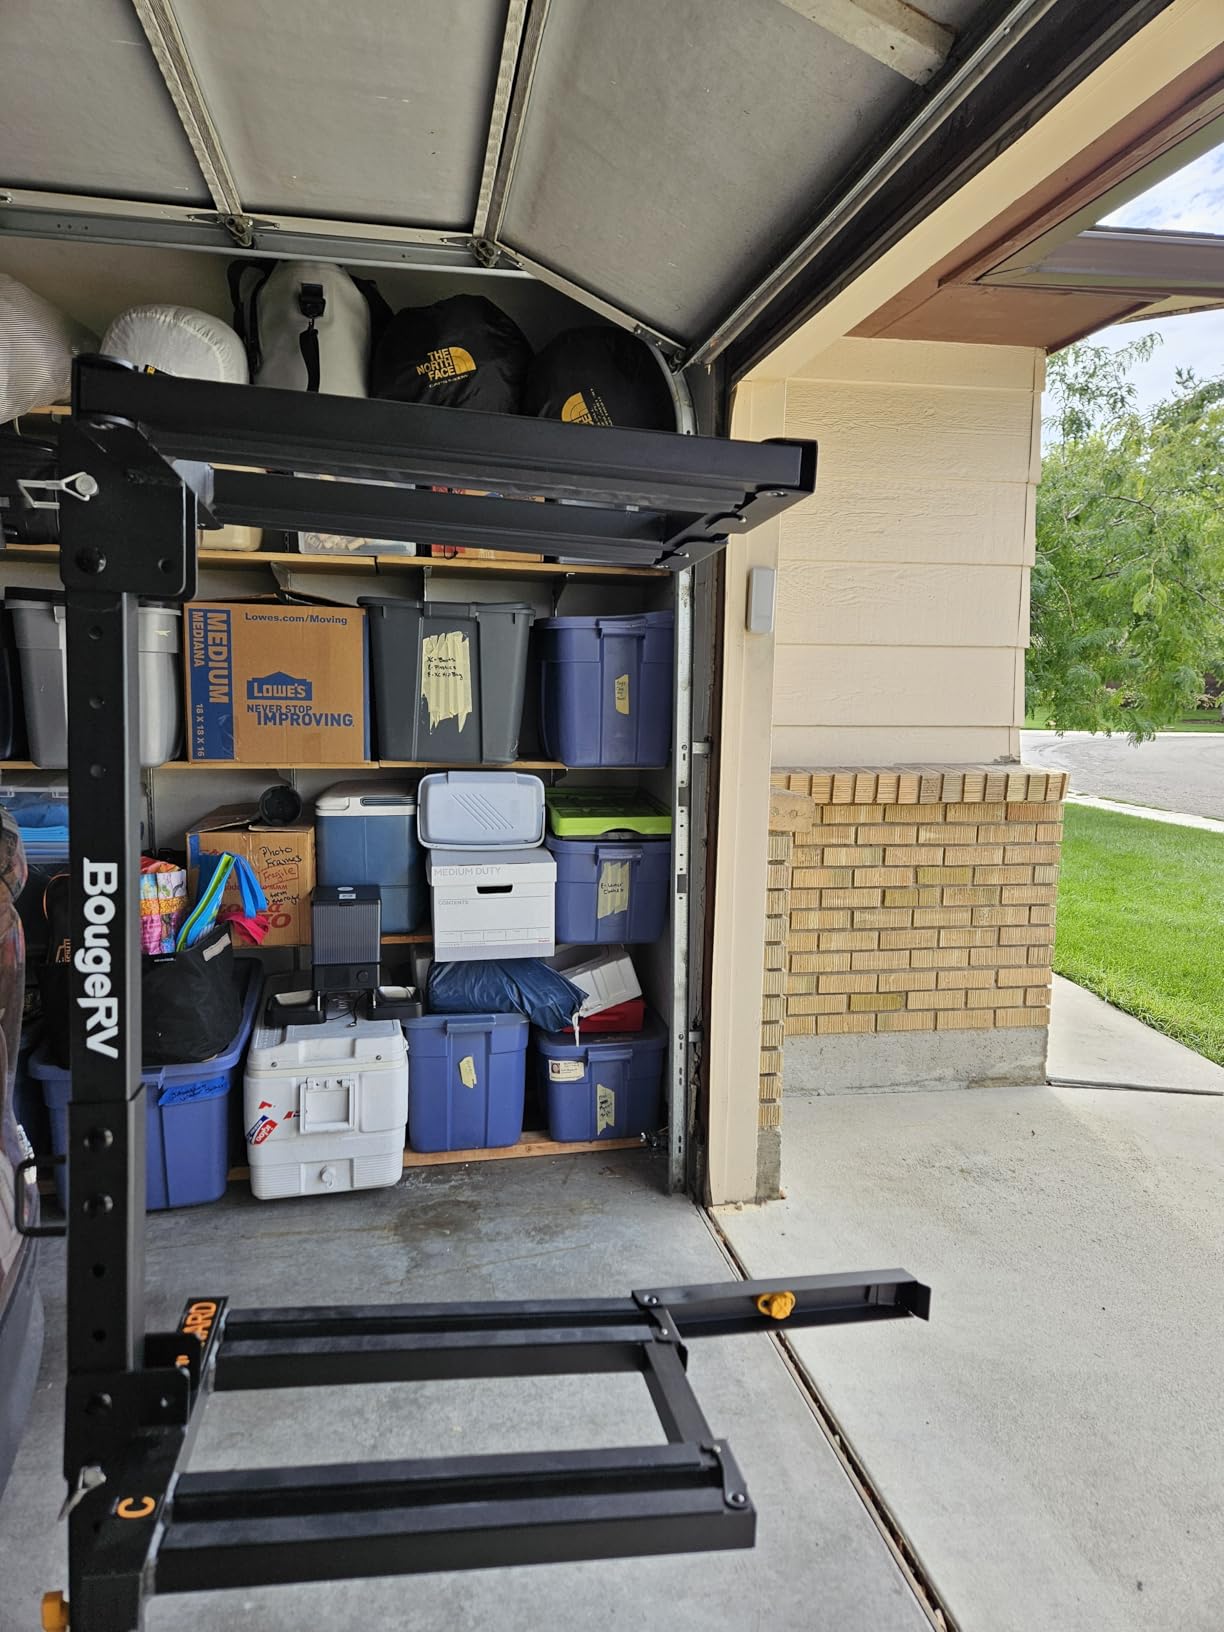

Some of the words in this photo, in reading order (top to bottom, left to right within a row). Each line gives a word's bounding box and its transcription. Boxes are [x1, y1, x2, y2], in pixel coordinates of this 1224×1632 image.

[427, 348, 450, 361] THE
[416, 355, 453, 376] NORTH
[428, 366, 456, 381] FACE
[245, 612, 348, 626] Lowes.com/Moving
[192, 611, 205, 667] MEDIANA
[207, 612, 229, 704] MEDIUM
[195, 703, 204, 714] 18
[246, 703, 282, 714] NEVER
[285, 704, 313, 714] STOP
[196, 715, 204, 723] X
[196, 725, 205, 736] 18
[260, 846, 293, 858] Photo
[266, 854, 303, 869] Frames
[263, 867, 297, 882] Fragile
[434, 868, 473, 876] MEDIUM
[475, 867, 501, 876] DUTY
[74, 857, 119, 1060] BougeRV
